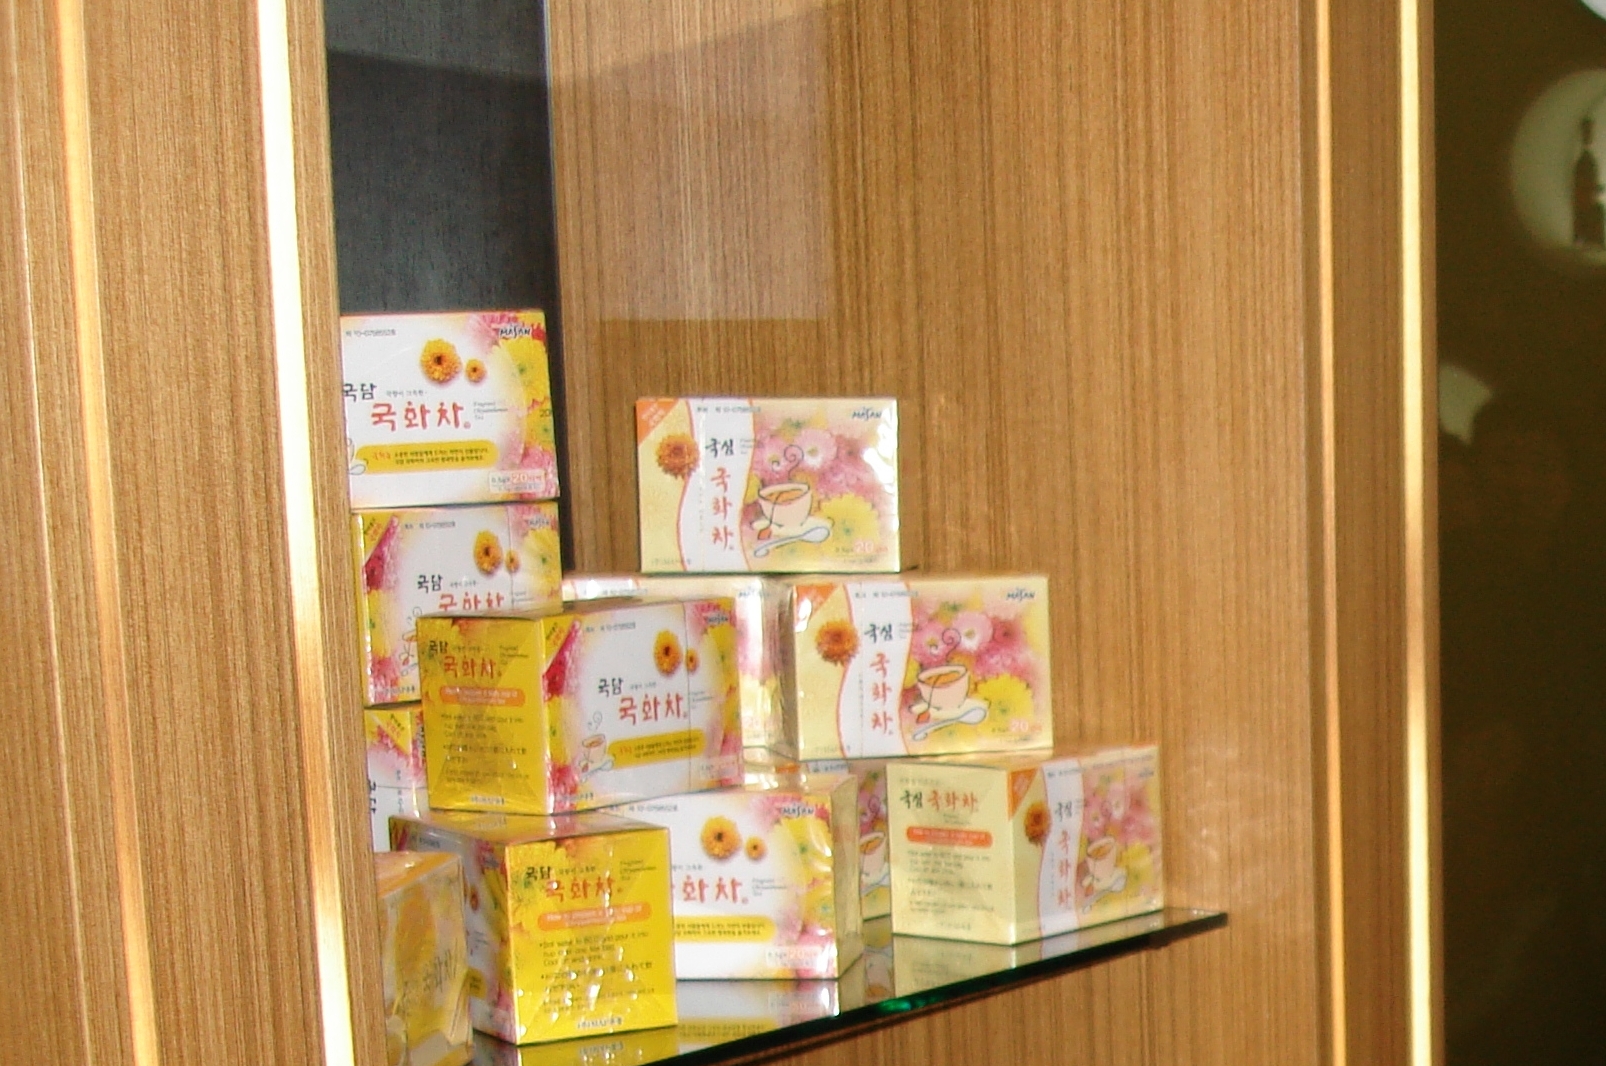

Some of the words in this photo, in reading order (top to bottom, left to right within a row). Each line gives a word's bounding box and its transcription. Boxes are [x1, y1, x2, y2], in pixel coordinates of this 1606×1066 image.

[371, 401, 464, 432] 국화차
[710, 468, 734, 549] 국화차
[444, 655, 496, 679] 국화차
[619, 692, 684, 725] 국화차
[870, 652, 893, 735] 국화차
[546, 876, 615, 903] 국화차
[672, 875, 742, 904] 화차
